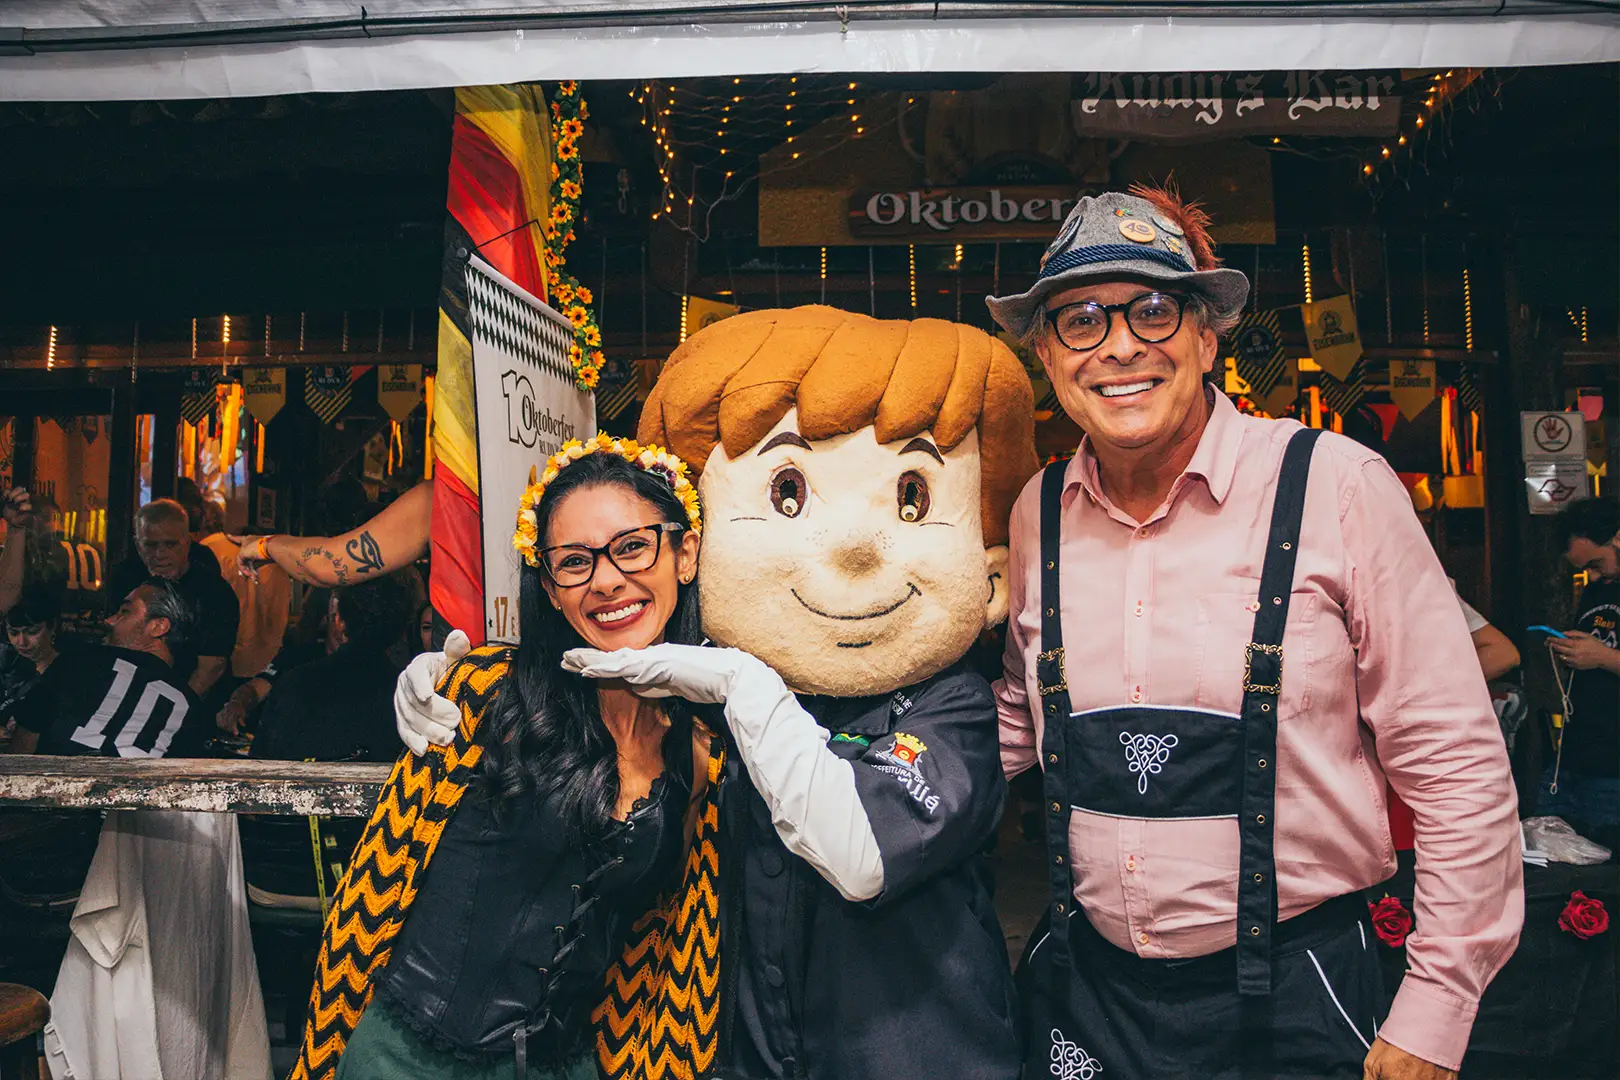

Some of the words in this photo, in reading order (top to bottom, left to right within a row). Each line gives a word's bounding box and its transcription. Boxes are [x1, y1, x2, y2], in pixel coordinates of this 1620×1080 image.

[1081, 71, 1264, 124] Rudy's
[1285, 71, 1395, 120] Bar
[522, 394, 575, 444] Oktoberfest
[494, 596, 508, 637] 17
[70, 657, 190, 758] 10
